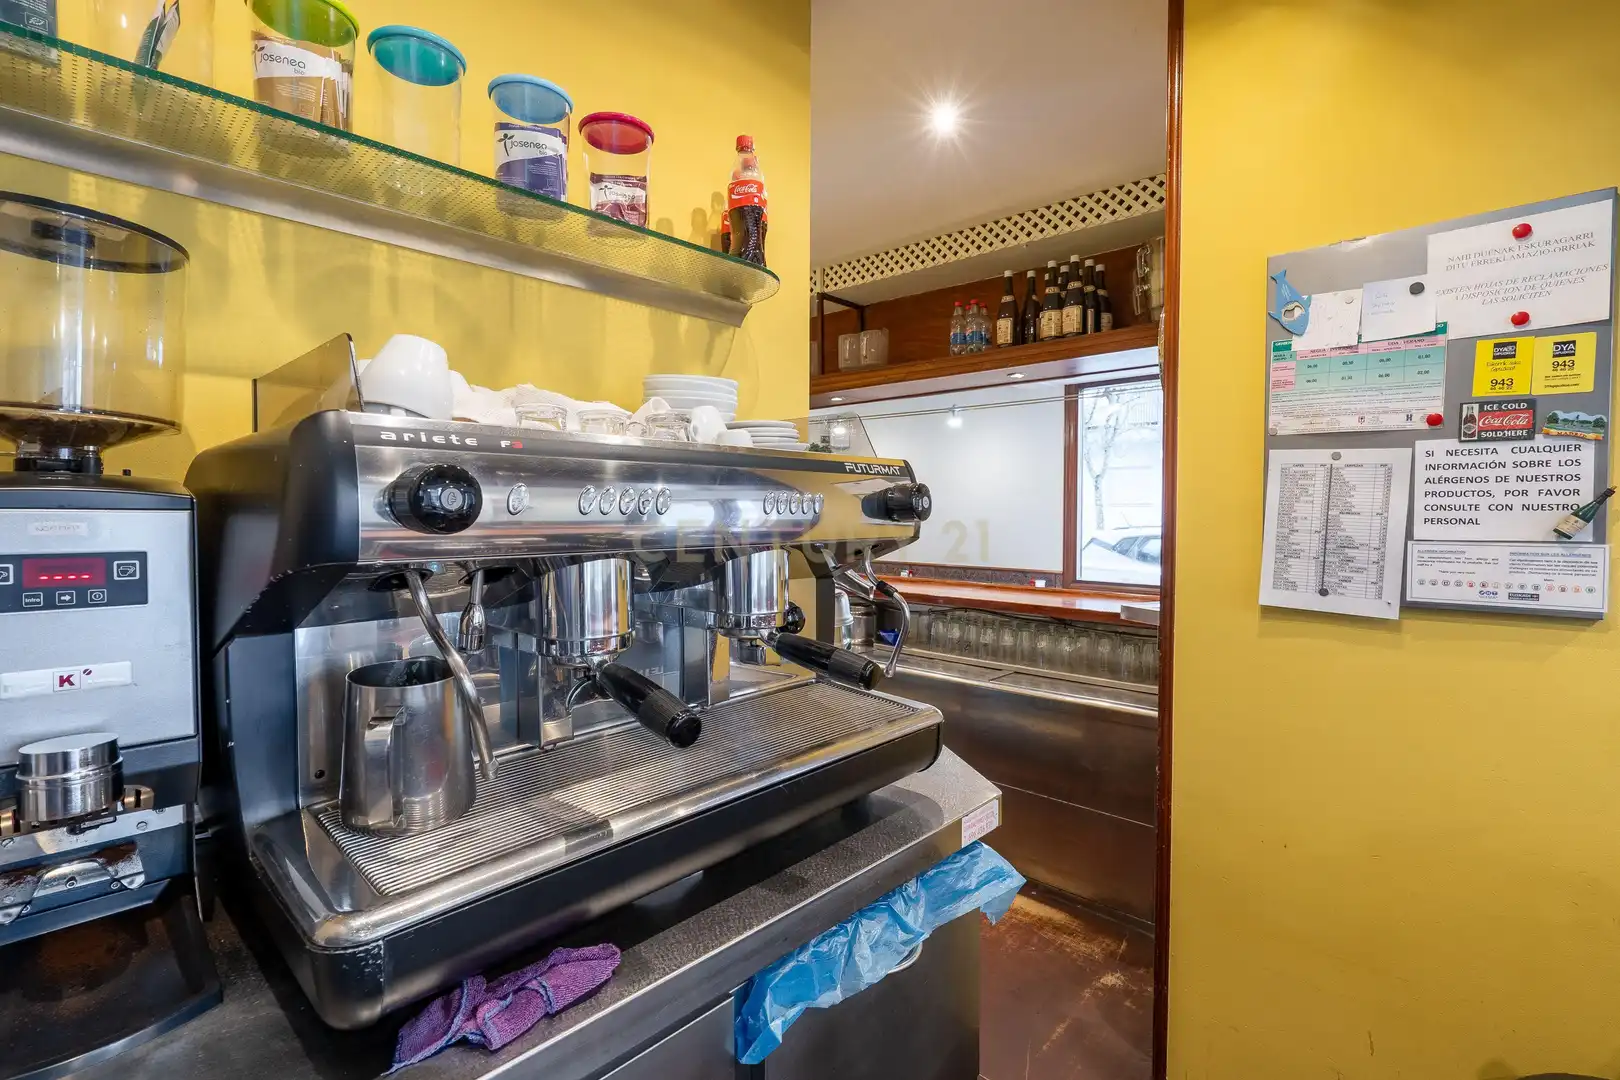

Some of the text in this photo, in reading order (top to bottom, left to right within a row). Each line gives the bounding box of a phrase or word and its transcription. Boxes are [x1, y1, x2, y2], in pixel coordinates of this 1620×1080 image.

[1505, 278, 1519, 286] DE
[1553, 343, 1575, 352] DYA
[1552, 360, 1575, 368] 943
[1490, 378, 1514, 387] 943
[380, 431, 478, 446] ariete
[1446, 447, 1499, 457] NECESITA
[1511, 444, 1582, 454] CUALQUIER
[844, 462, 900, 475] FUTURMAT
[1425, 459, 1582, 471] INFORMACIÓN SOBRE LOS
[1424, 474, 1581, 484] ALÉRGENOS DE NUESTROS
[1424, 490, 1496, 498] PRODUCTOS,
[1504, 489, 1528, 497] POR
[1522, 503, 1580, 511] NUESTRO
[58, 674, 76, 688] K
